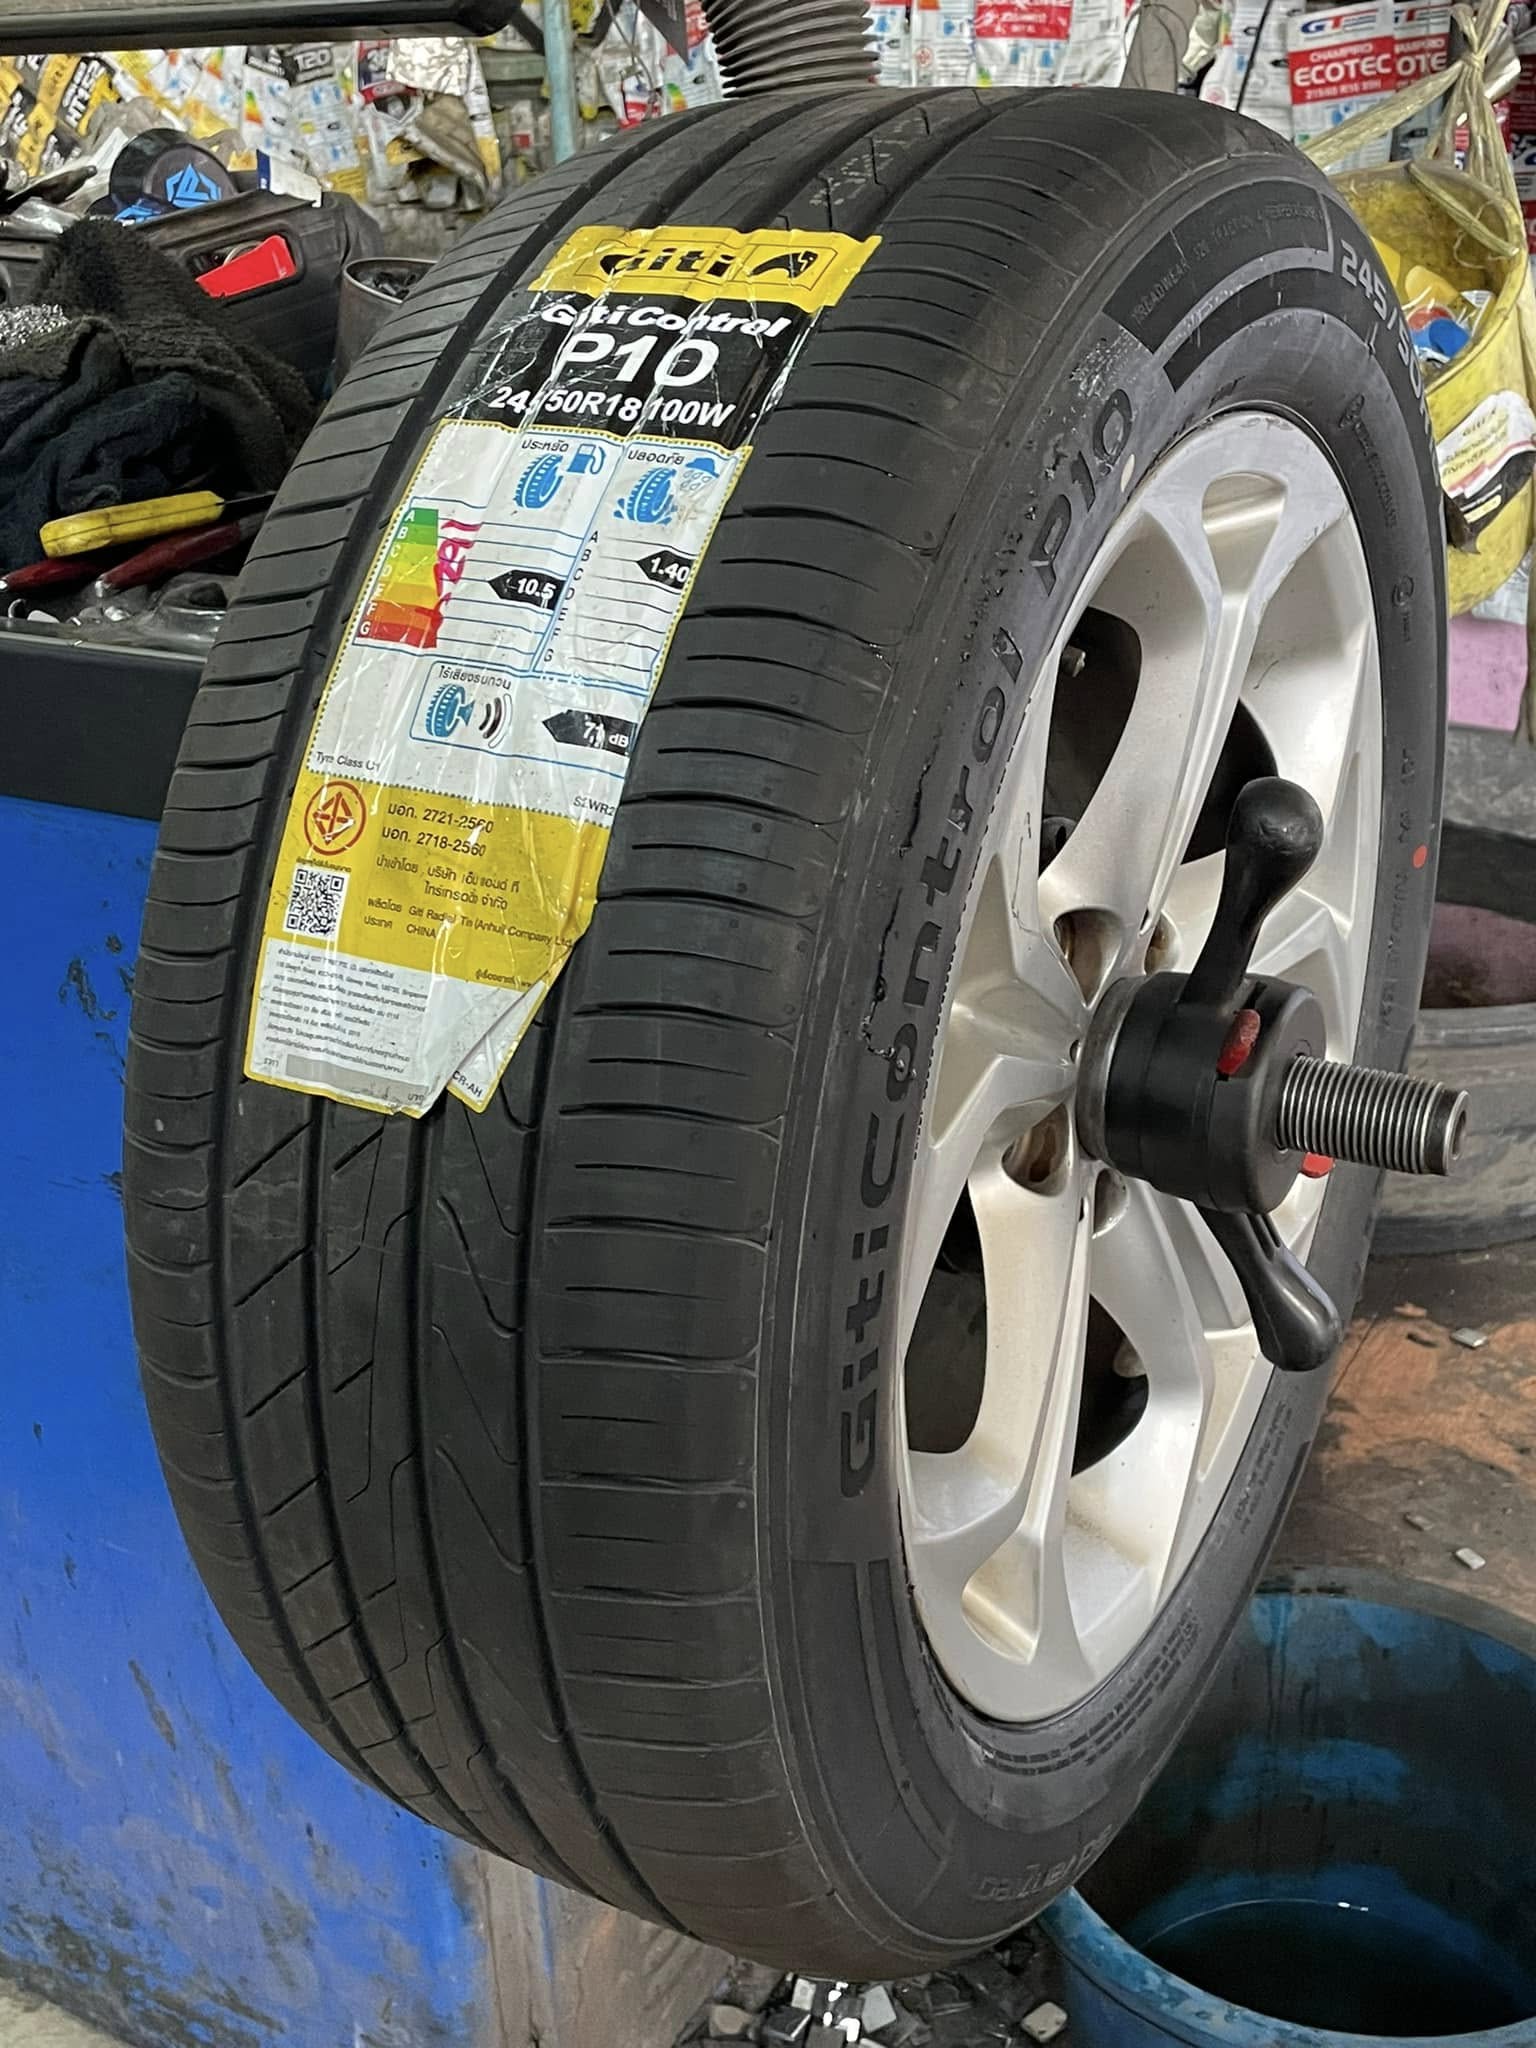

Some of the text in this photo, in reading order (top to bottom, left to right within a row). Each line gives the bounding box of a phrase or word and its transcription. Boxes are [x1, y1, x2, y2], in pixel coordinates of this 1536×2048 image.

[1294, 53, 1392, 87] ECOTEC
[541, 303, 792, 338] GitiControl
[556, 331, 719, 388] P10
[648, 397, 736, 427] 100W
[521, 438, 569, 453] ประหยัด
[628, 449, 685, 465] ปลอดภัย
[405, 510, 415, 522] A
[397, 527, 408, 539] B
[590, 530, 599, 543] A
[581, 549, 592, 562] B
[573, 568, 584, 581] C
[651, 557, 690, 583] 1.40
[518, 578, 556, 600] 10.5
[366, 602, 377, 616] F
[558, 607, 569, 621] E
[360, 621, 371, 635] G
[543, 648, 554, 662] G
[608, 733, 629, 748] dB
[337, 755, 363, 769] Class
[387, 803, 495, 834] มอก. 2721-2560
[382, 826, 487, 857] มอก. 2718-2560
[406, 923, 437, 939] CHINA
[507, 926, 551, 946] Company
[840, 388, 1133, 1498] GitiControl P10
